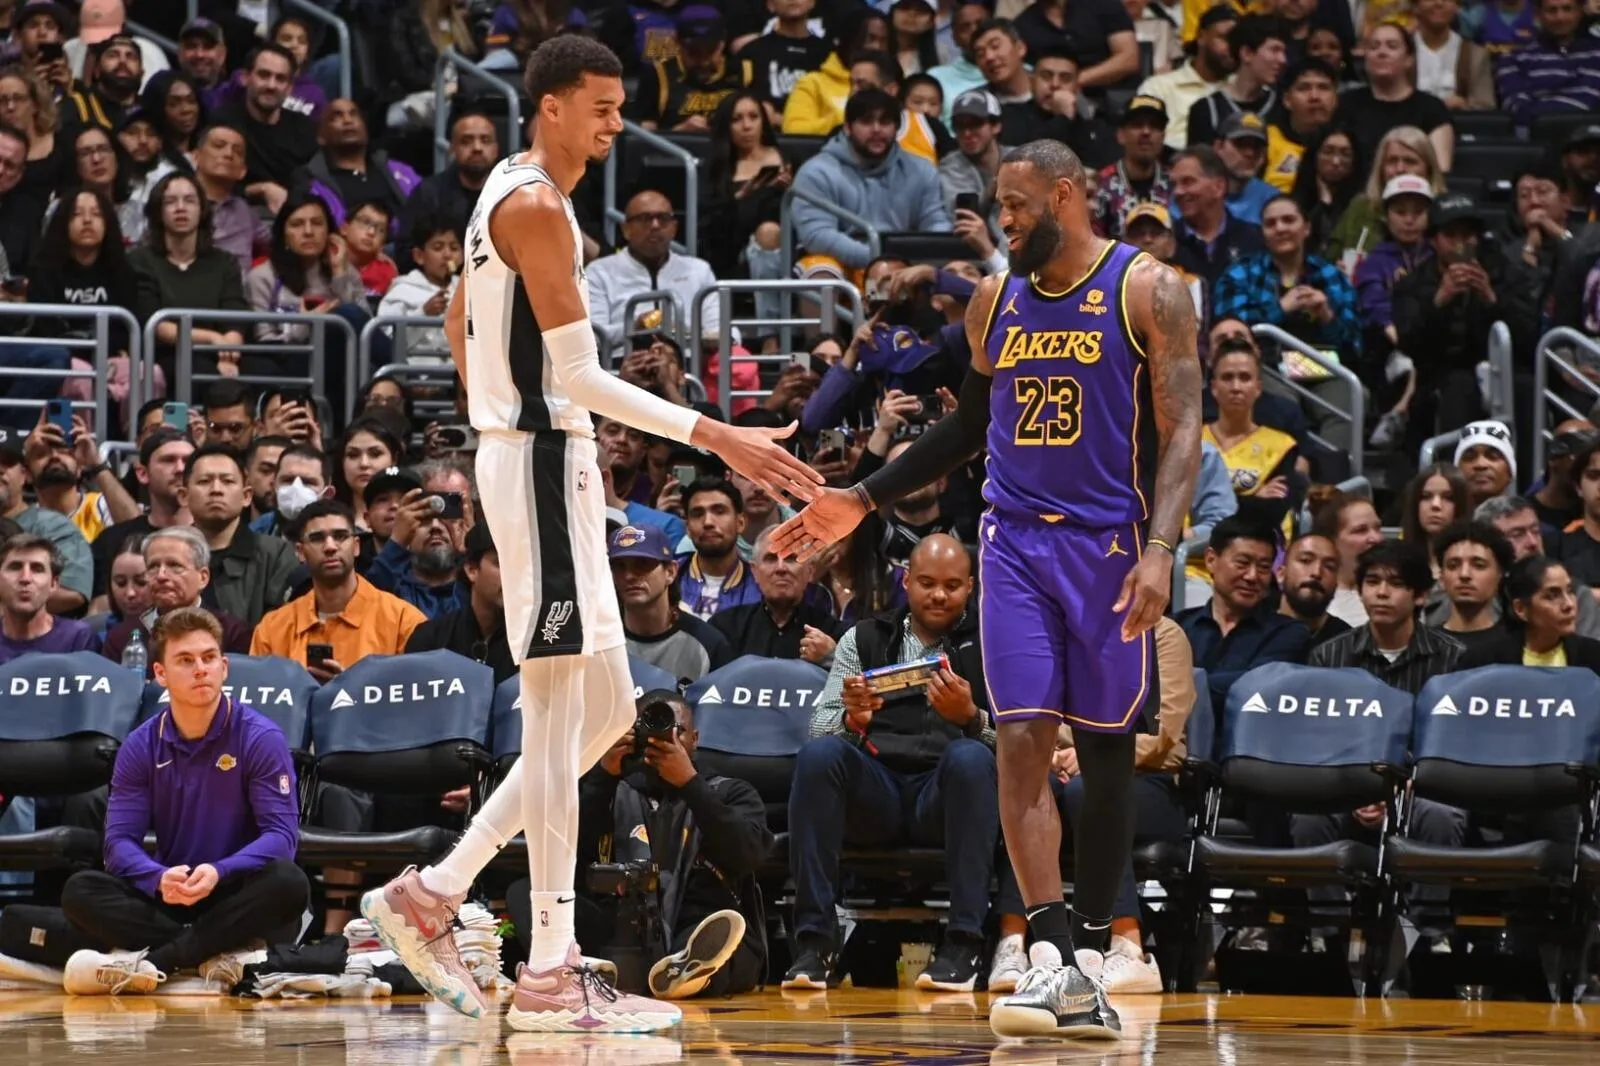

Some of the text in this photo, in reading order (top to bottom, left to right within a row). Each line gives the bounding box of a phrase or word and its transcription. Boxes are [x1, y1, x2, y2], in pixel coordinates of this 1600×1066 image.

[1079, 303, 1107, 315] bibigo
[995, 326, 1103, 369] LAKERS
[1014, 376, 1083, 446] 23
[10, 675, 111, 696] DELTA
[221, 685, 294, 706] ELTA
[364, 677, 466, 704] DELTA
[1278, 694, 1383, 718] DELTA
[1469, 696, 1576, 718] DELTA
